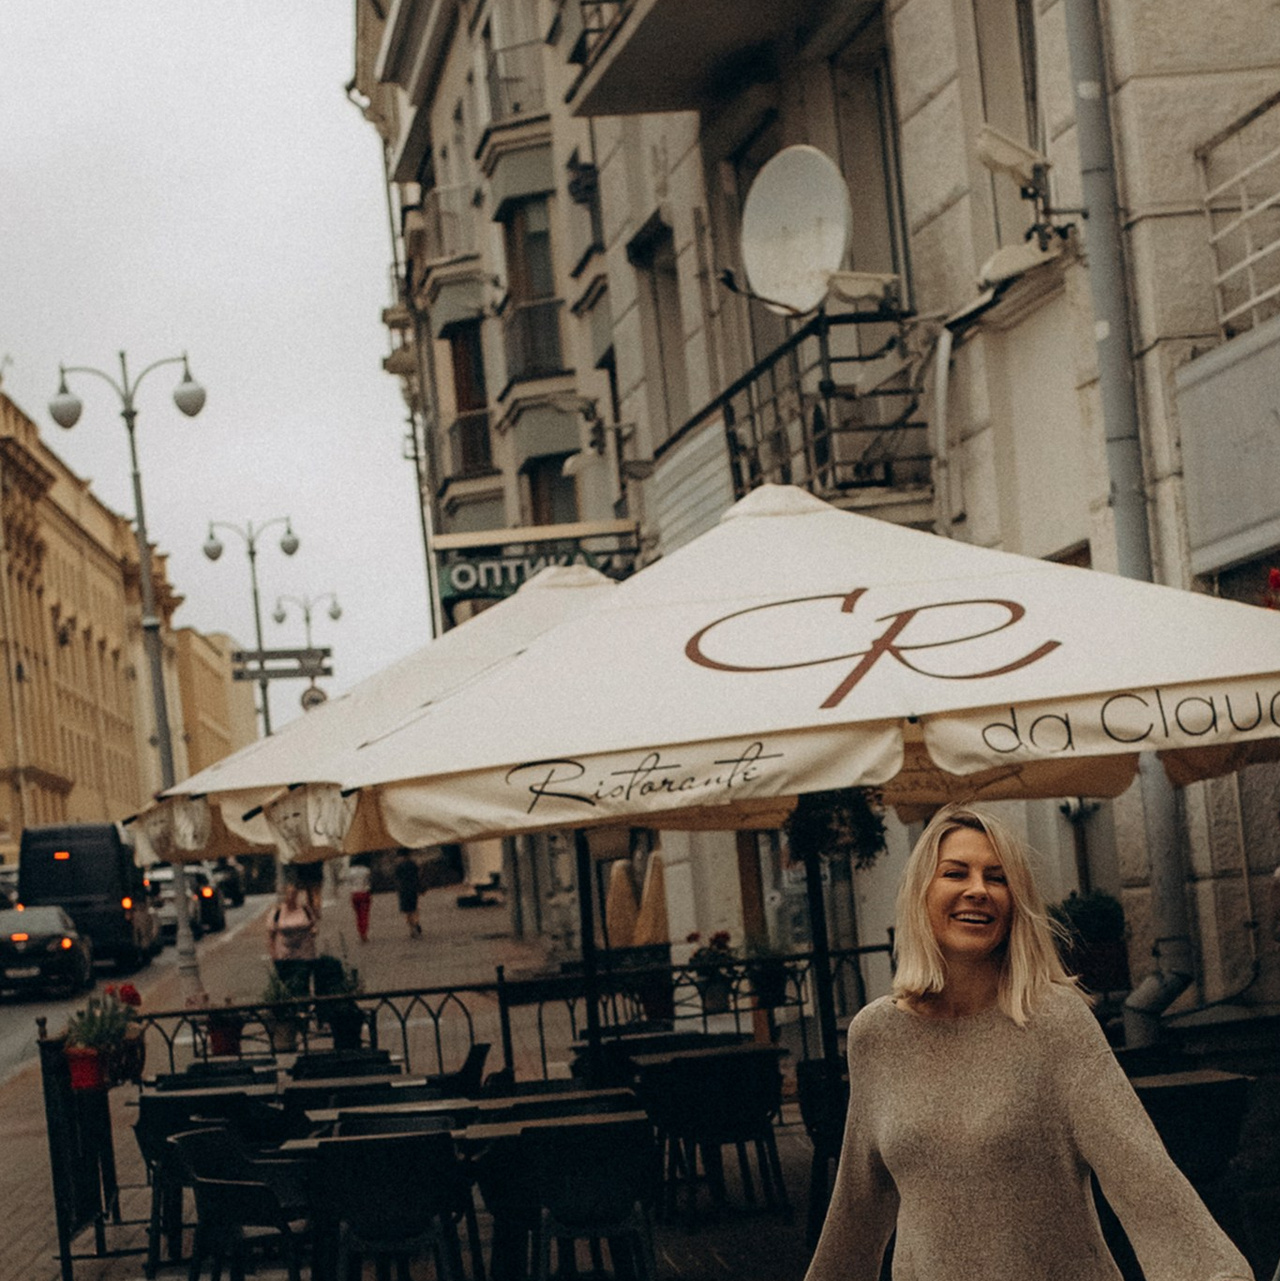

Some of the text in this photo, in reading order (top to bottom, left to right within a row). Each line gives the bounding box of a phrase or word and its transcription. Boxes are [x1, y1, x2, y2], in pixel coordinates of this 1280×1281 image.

[685, 587, 1062, 709] CR
[981, 707, 1074, 754] da
[505, 742, 784, 814] Ristorante
